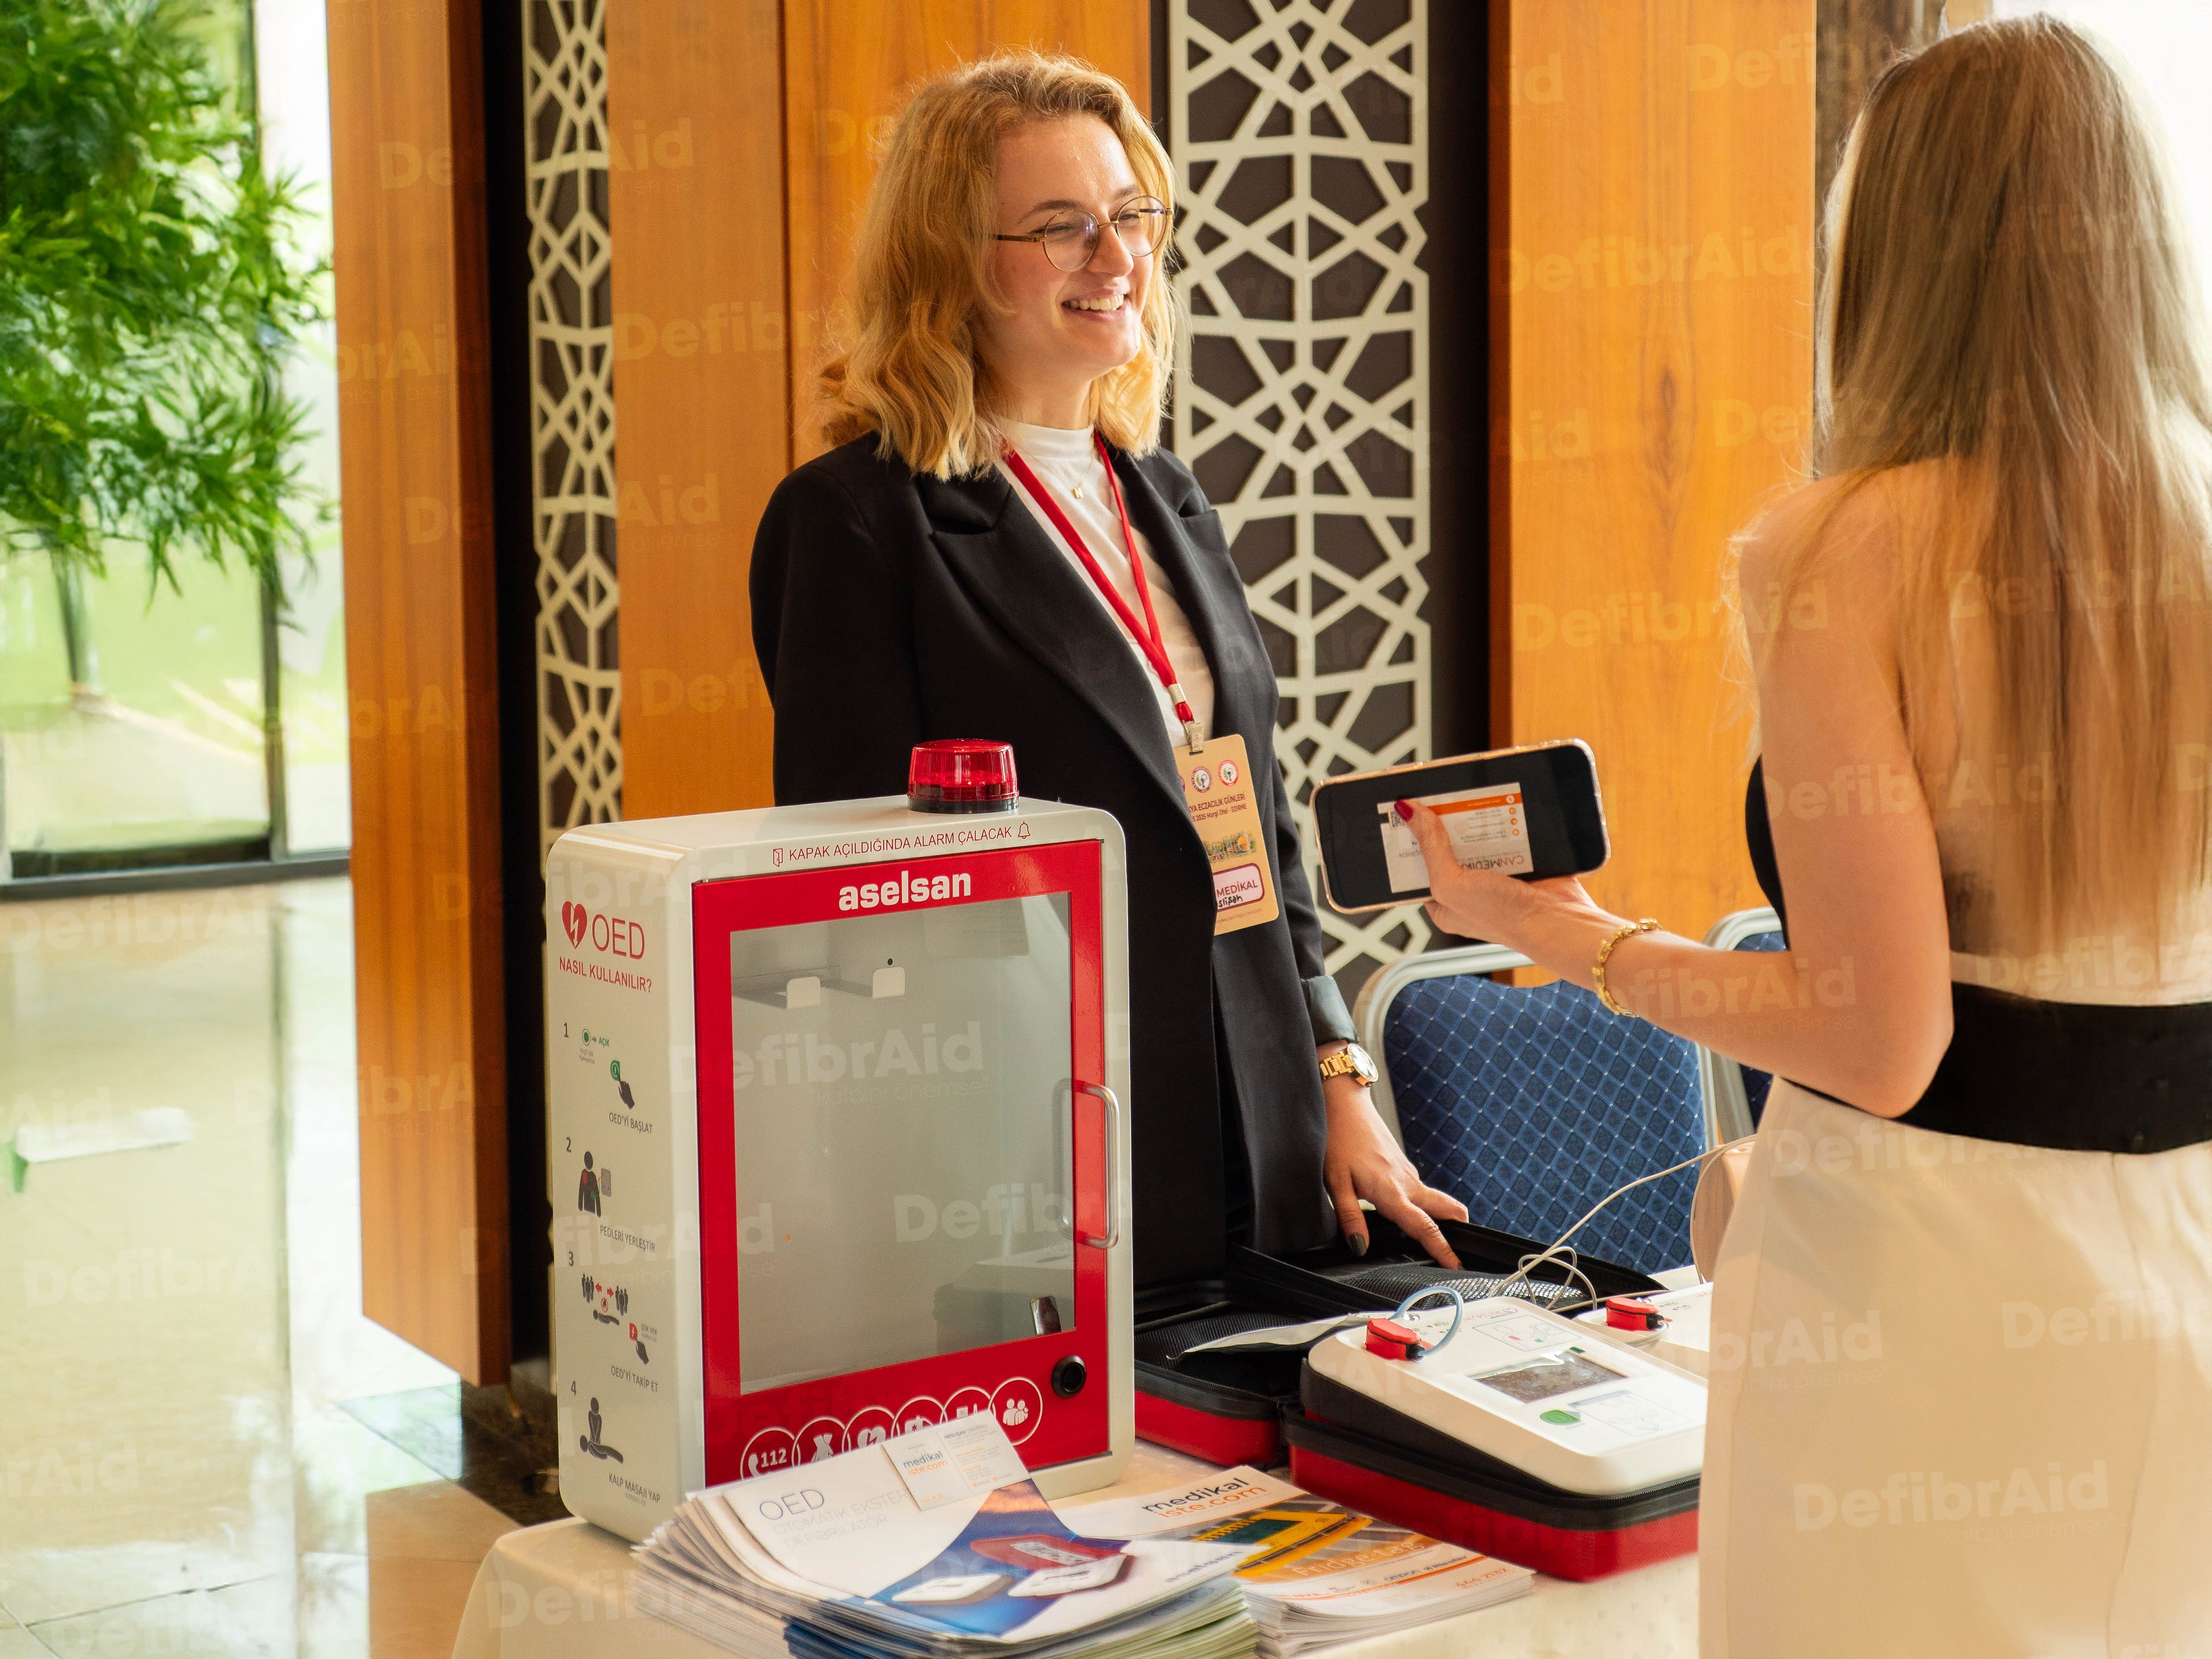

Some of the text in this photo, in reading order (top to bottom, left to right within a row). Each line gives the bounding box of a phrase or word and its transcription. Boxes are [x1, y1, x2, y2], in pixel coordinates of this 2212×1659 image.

[1198, 798, 1224, 811] ECZACILIK
[1224, 793, 1246, 804] GÜNLERİ
[789, 826, 1012, 861] KAPAK AÇILDIĞINDA ALARM ÇALACAK
[839, 870, 971, 912] aselsan
[1216, 879, 1258, 898] MEDİKAL
[592, 914, 645, 960] OED
[559, 957, 652, 993] NASIL KULLANILIR?
[563, 1023, 569, 1039] 1
[598, 1037, 610, 1048] AÇIK
[631, 1118, 653, 1134] BAŞLAT
[566, 1137, 572, 1153] 2
[600, 1225, 655, 1253] PEDLERİ YERLEŞTİR
[568, 1251, 574, 1267] 3
[571, 1381, 577, 1396] 4
[632, 1374, 650, 1389] TAKİP
[650, 1382, 658, 1393] ET
[761, 1449, 787, 1468] 112
[903, 1450, 944, 1469] medikal
[908, 1460, 949, 1477] iste.com
[609, 1473, 661, 1504] KALP MASAJI YAP
[1141, 1478, 1250, 1512] medikal
[759, 1489, 824, 1520] OED
[1153, 1486, 1267, 1518] iste.com
